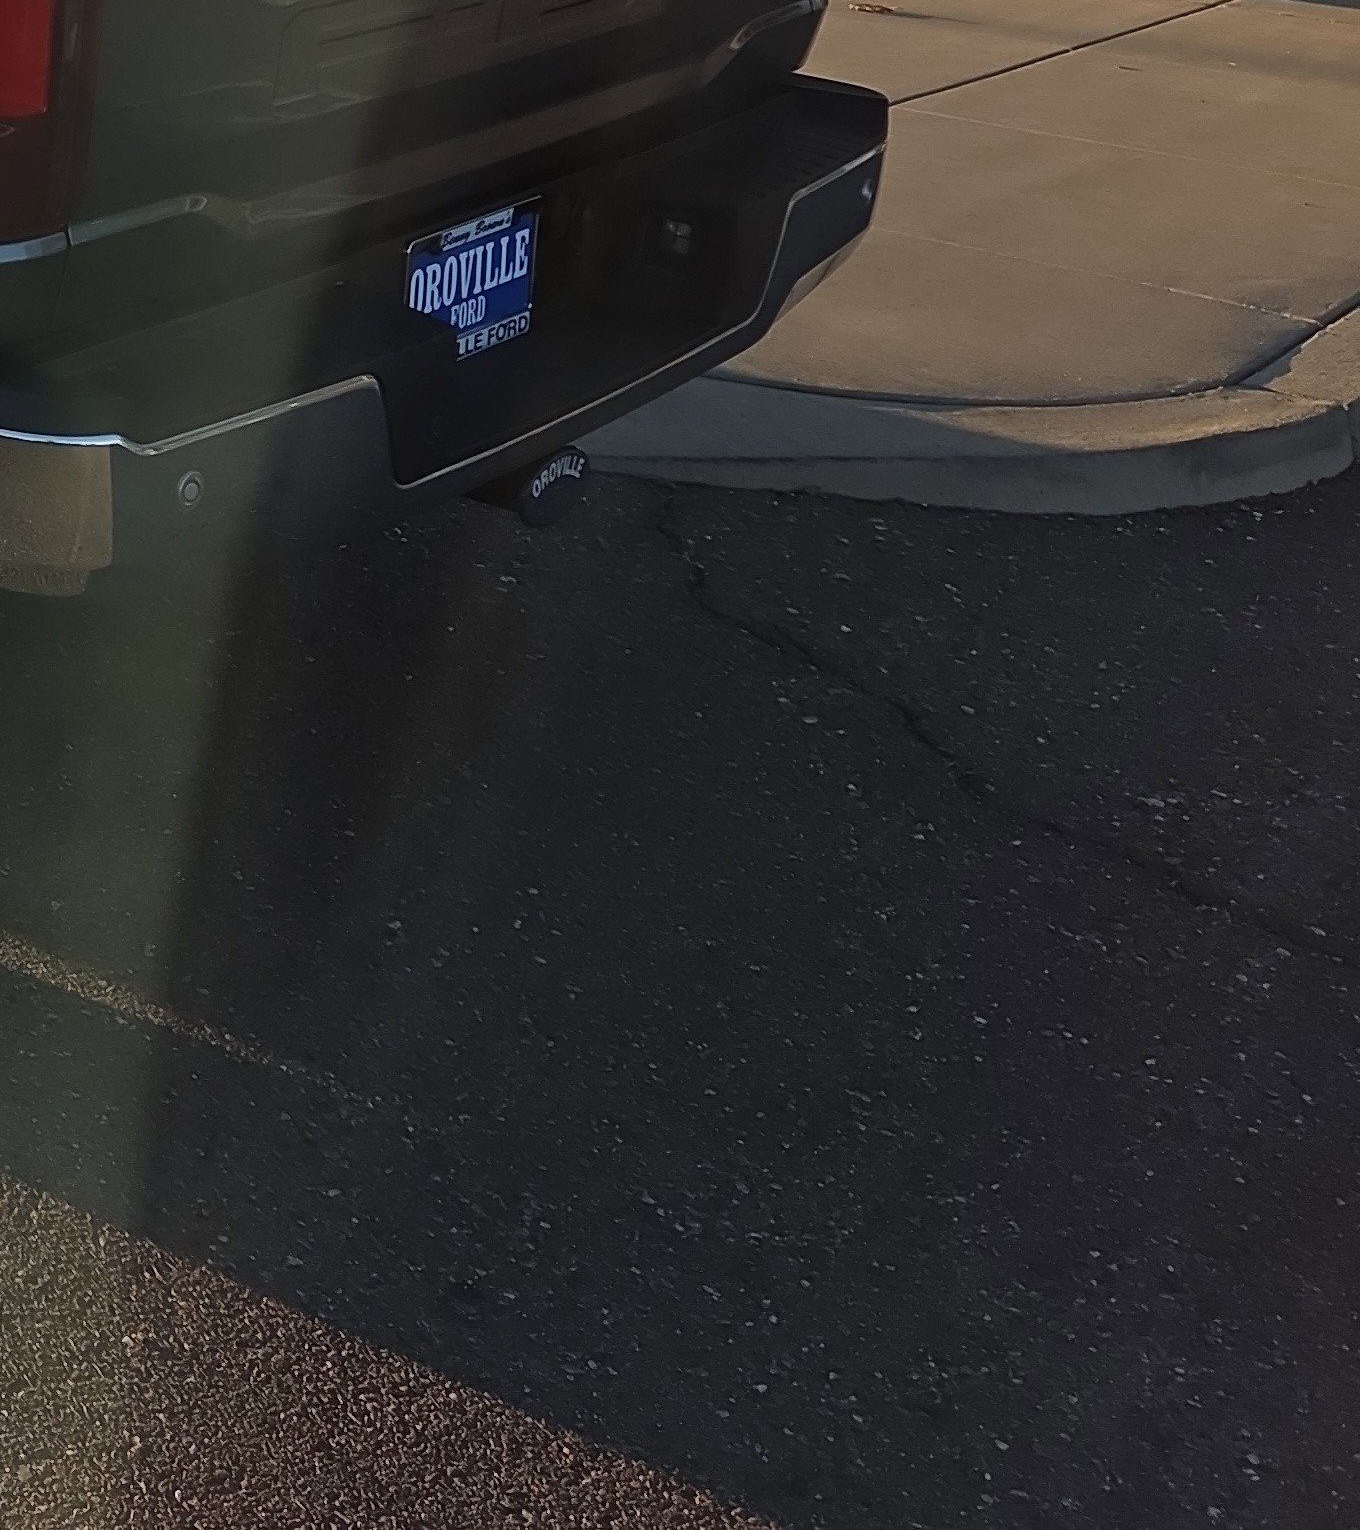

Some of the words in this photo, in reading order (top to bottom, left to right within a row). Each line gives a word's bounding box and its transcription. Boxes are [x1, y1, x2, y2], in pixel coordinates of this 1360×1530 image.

[409, 228, 530, 314] OROVILLE
[450, 295, 486, 330] FORD
[487, 315, 529, 346] FORD
[532, 455, 585, 498] OROVILLE
